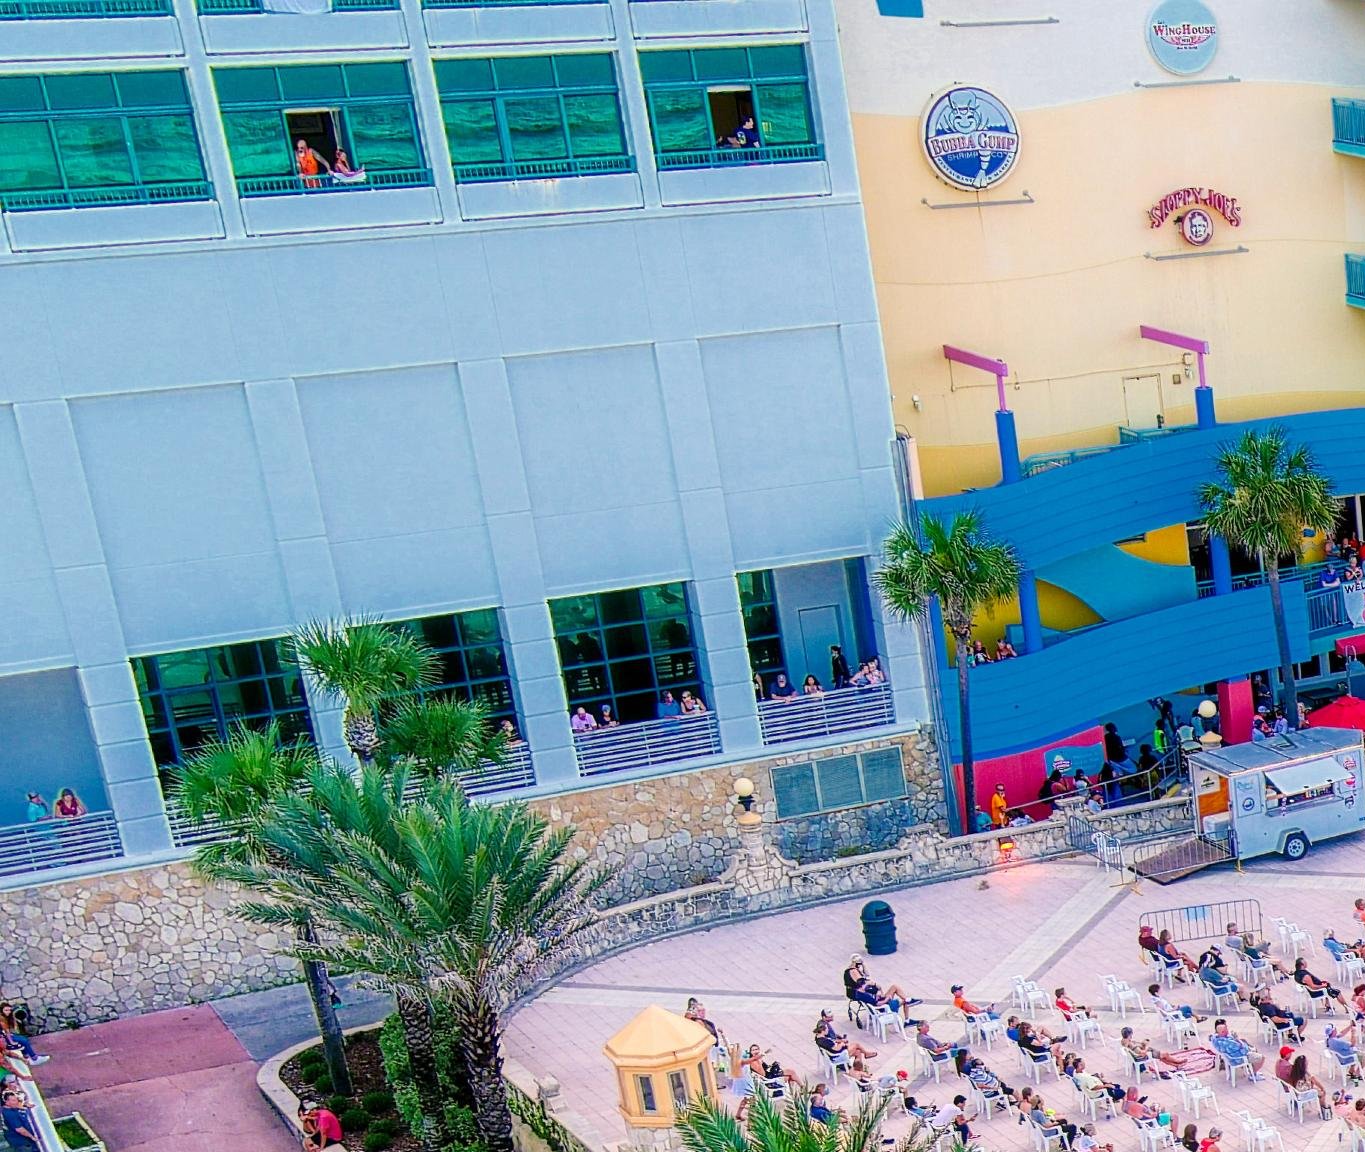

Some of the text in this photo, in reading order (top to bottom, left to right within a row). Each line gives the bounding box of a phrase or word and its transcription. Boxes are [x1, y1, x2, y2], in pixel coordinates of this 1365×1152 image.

[931, 132, 1016, 155] BUBBA GUMP
[947, 151, 979, 161] SHRIMP
[1149, 187, 1204, 229] SLOPPY
